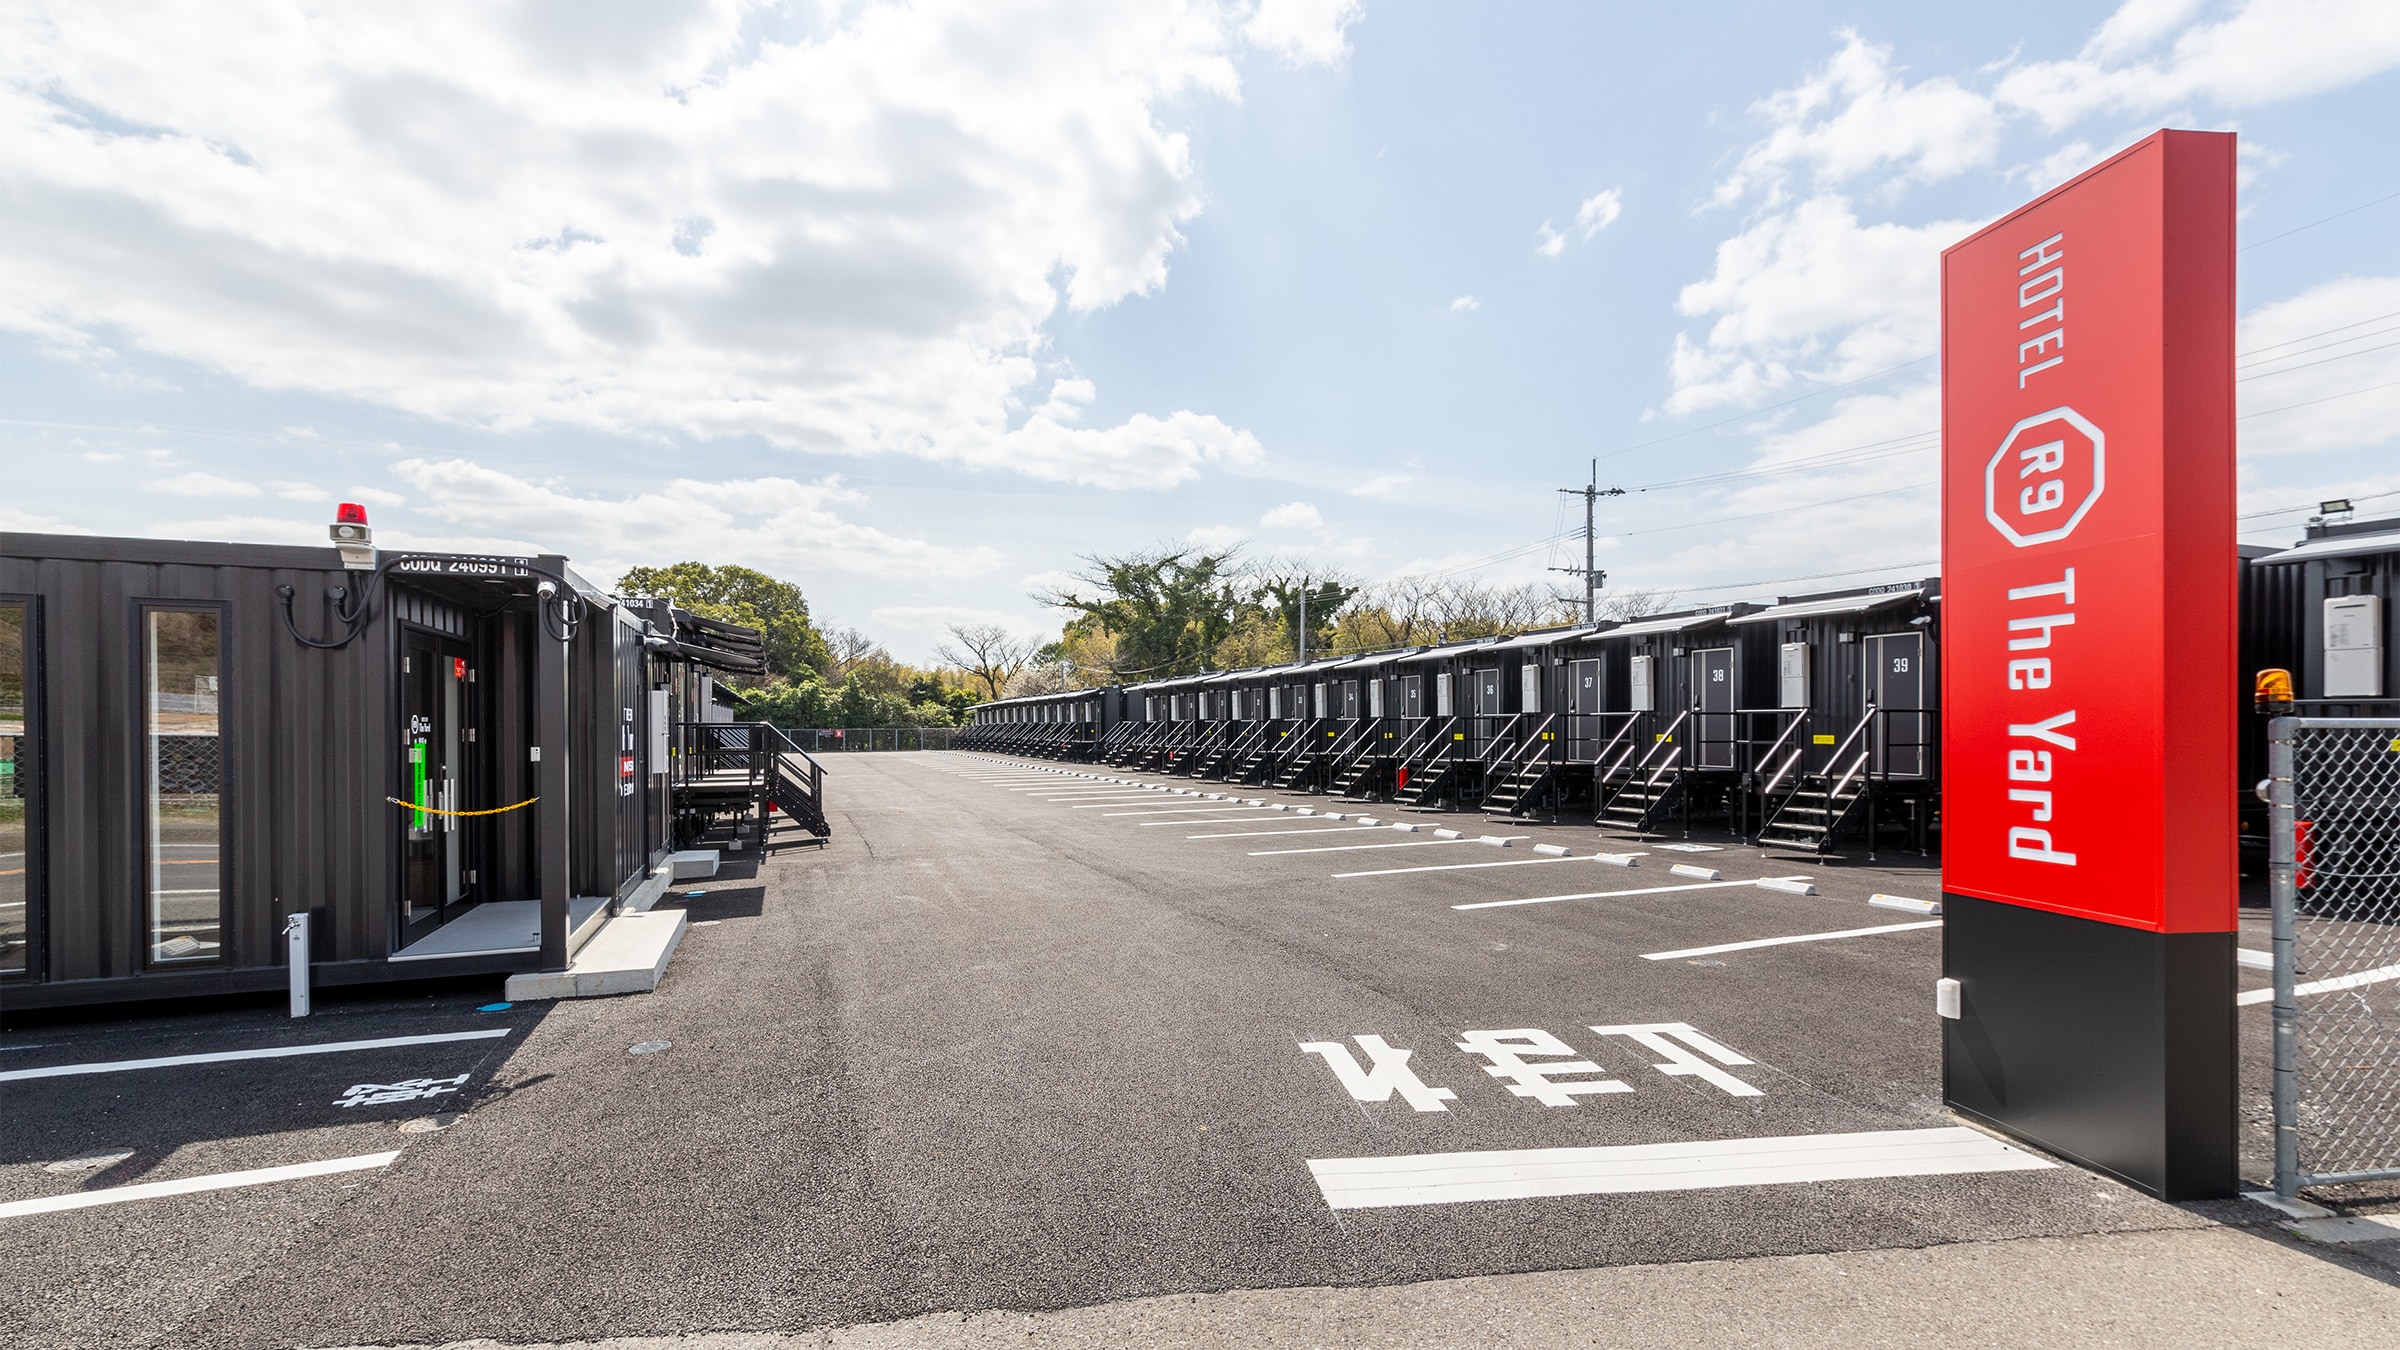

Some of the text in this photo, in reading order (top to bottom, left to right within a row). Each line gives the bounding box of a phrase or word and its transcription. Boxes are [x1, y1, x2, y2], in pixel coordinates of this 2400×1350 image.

[2007, 231, 2078, 868] HOTEL R9 The Yard
[1893, 658, 1908, 673] 39
[1584, 676, 1593, 688] 37
[1713, 669, 1724, 683] 38
[1486, 685, 1494, 695] 36
[1299, 1022, 1766, 1112] 止まれ
[332, 1073, 471, 1108] 軽
